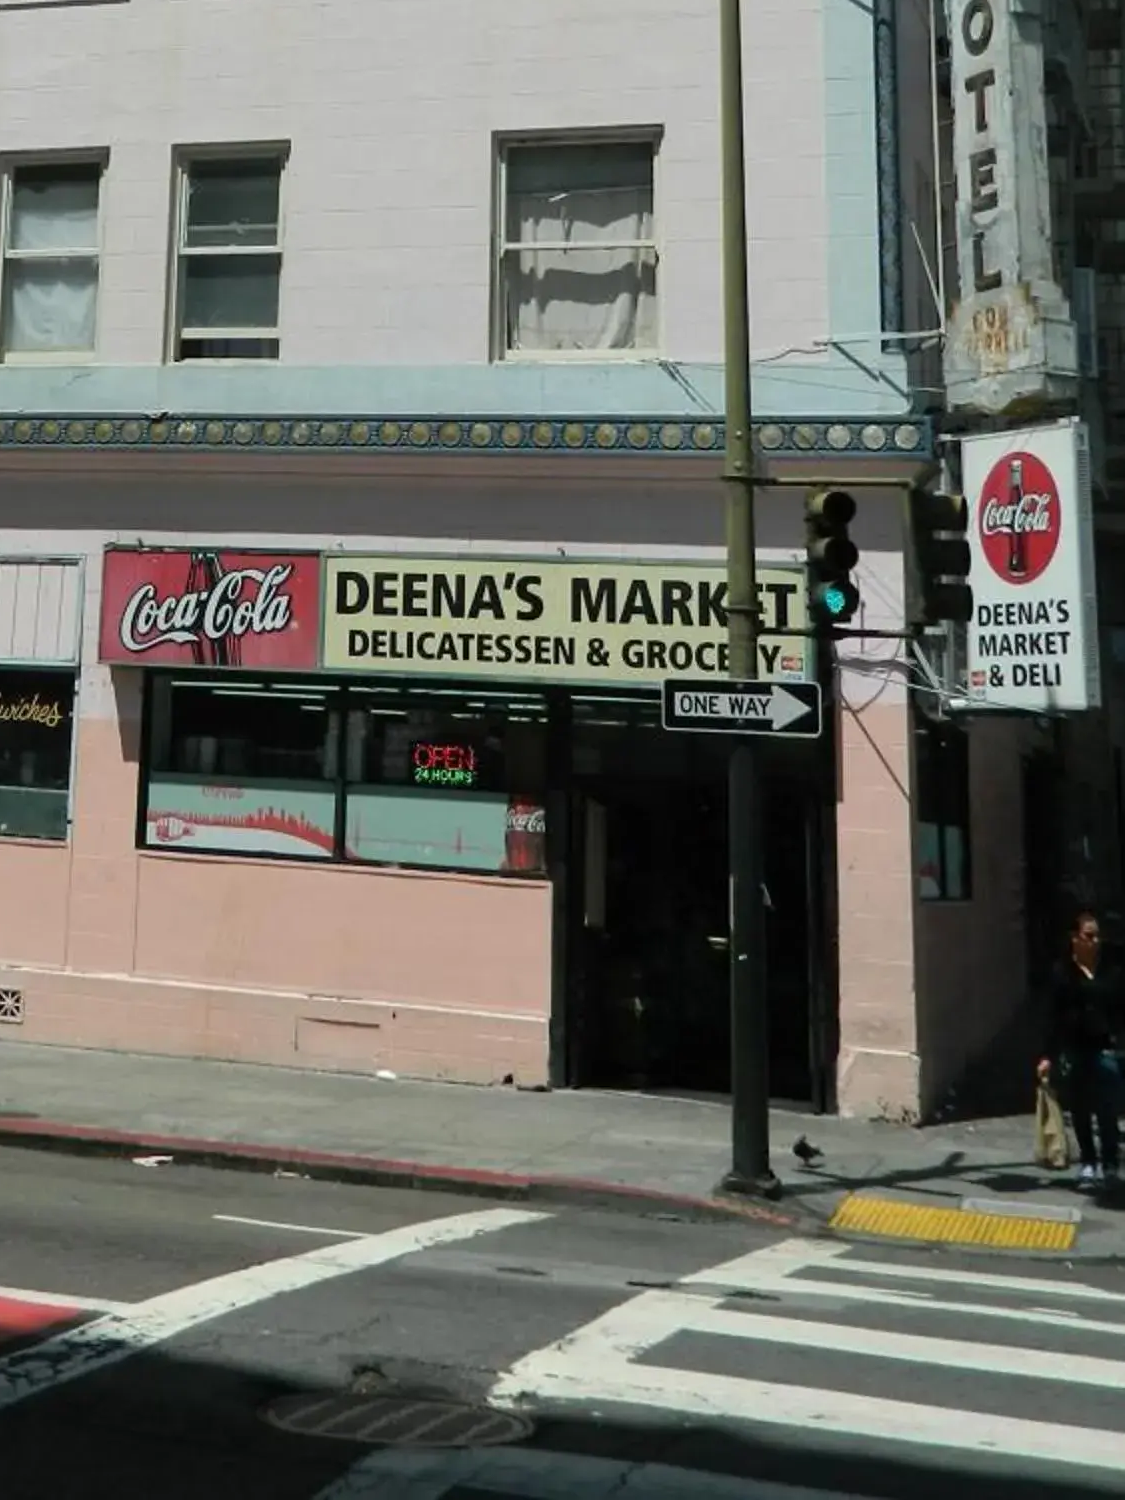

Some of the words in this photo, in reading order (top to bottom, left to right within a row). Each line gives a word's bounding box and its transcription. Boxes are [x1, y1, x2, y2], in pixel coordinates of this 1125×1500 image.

[982, 493, 1052, 535] Coca-Cola
[121, 564, 292, 651] Coca-Cola
[336, 571, 544, 621] DEENA'S
[978, 599, 1070, 626] DEENA'S
[348, 629, 575, 666] DELICATESSEN
[586, 638, 609, 667] &
[622, 639, 781, 674] GROCEY
[978, 632, 1070, 657] MARKET
[989, 664, 1004, 687] &
[1012, 663, 1061, 687] DELI
[679, 694, 720, 714] ONE
[728, 696, 770, 717] WAY
[413, 744, 475, 771] OPEN
